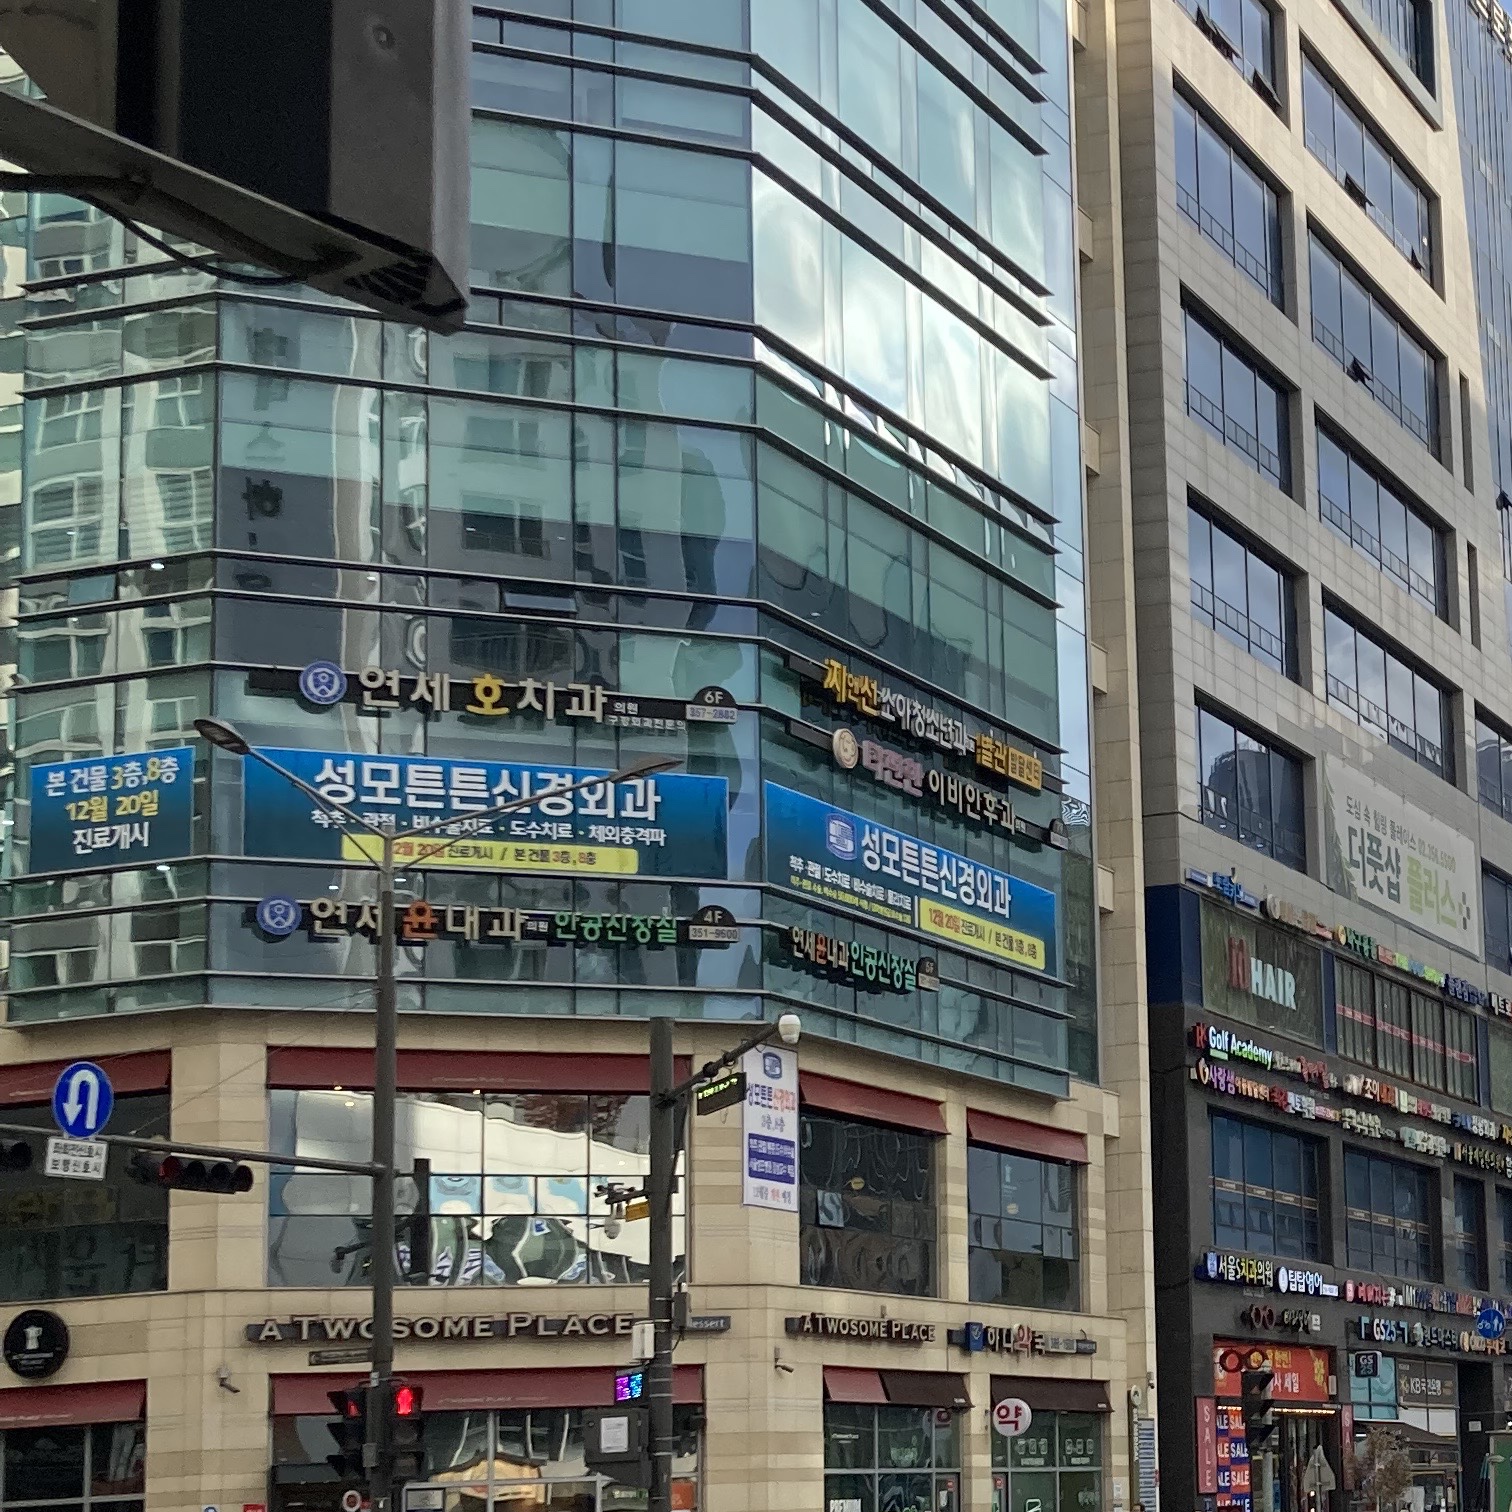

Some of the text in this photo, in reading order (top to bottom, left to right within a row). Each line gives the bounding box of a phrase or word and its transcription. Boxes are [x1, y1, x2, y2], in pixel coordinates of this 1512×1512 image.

[703, 690, 724, 705] 6F
[45, 769, 67, 797] 본
[70, 764, 109, 793] 건물
[314, 758, 662, 820] 성모튼튼신경외과
[64, 789, 159, 822] 12월 20일
[928, 768, 1016, 834] 이비인후과
[72, 820, 150, 855] 진료개시
[509, 820, 574, 840] 도수치료
[589, 824, 667, 846] 체외충격파
[861, 824, 1012, 919] 성모튼튼신경외과
[1348, 825, 1401, 904] 더풋샵
[1407, 855, 1457, 929] 플러스
[554, 911, 678, 943] 인공신장실
[703, 910, 723, 924] 4F
[850, 940, 917, 993] 인공신장실
[1250, 956, 1297, 1011] HAIR
[1208, 1025, 1229, 1052] Golf
[1230, 1033, 1273, 1071] Academy
[259, 1318, 283, 1341] A
[507, 1312, 634, 1337] PLACE
[803, 1314, 936, 1342] A TWOSOME PLACE
[987, 1324, 1046, 1358] 하나약국
[1373, 1318, 1397, 1342] GS25
[1359, 1355, 1374, 1365] GS
[996, 1404, 1023, 1432] 약
[1203, 1405, 1212, 1487] SALE
[1231, 1470, 1250, 1486] SALE
